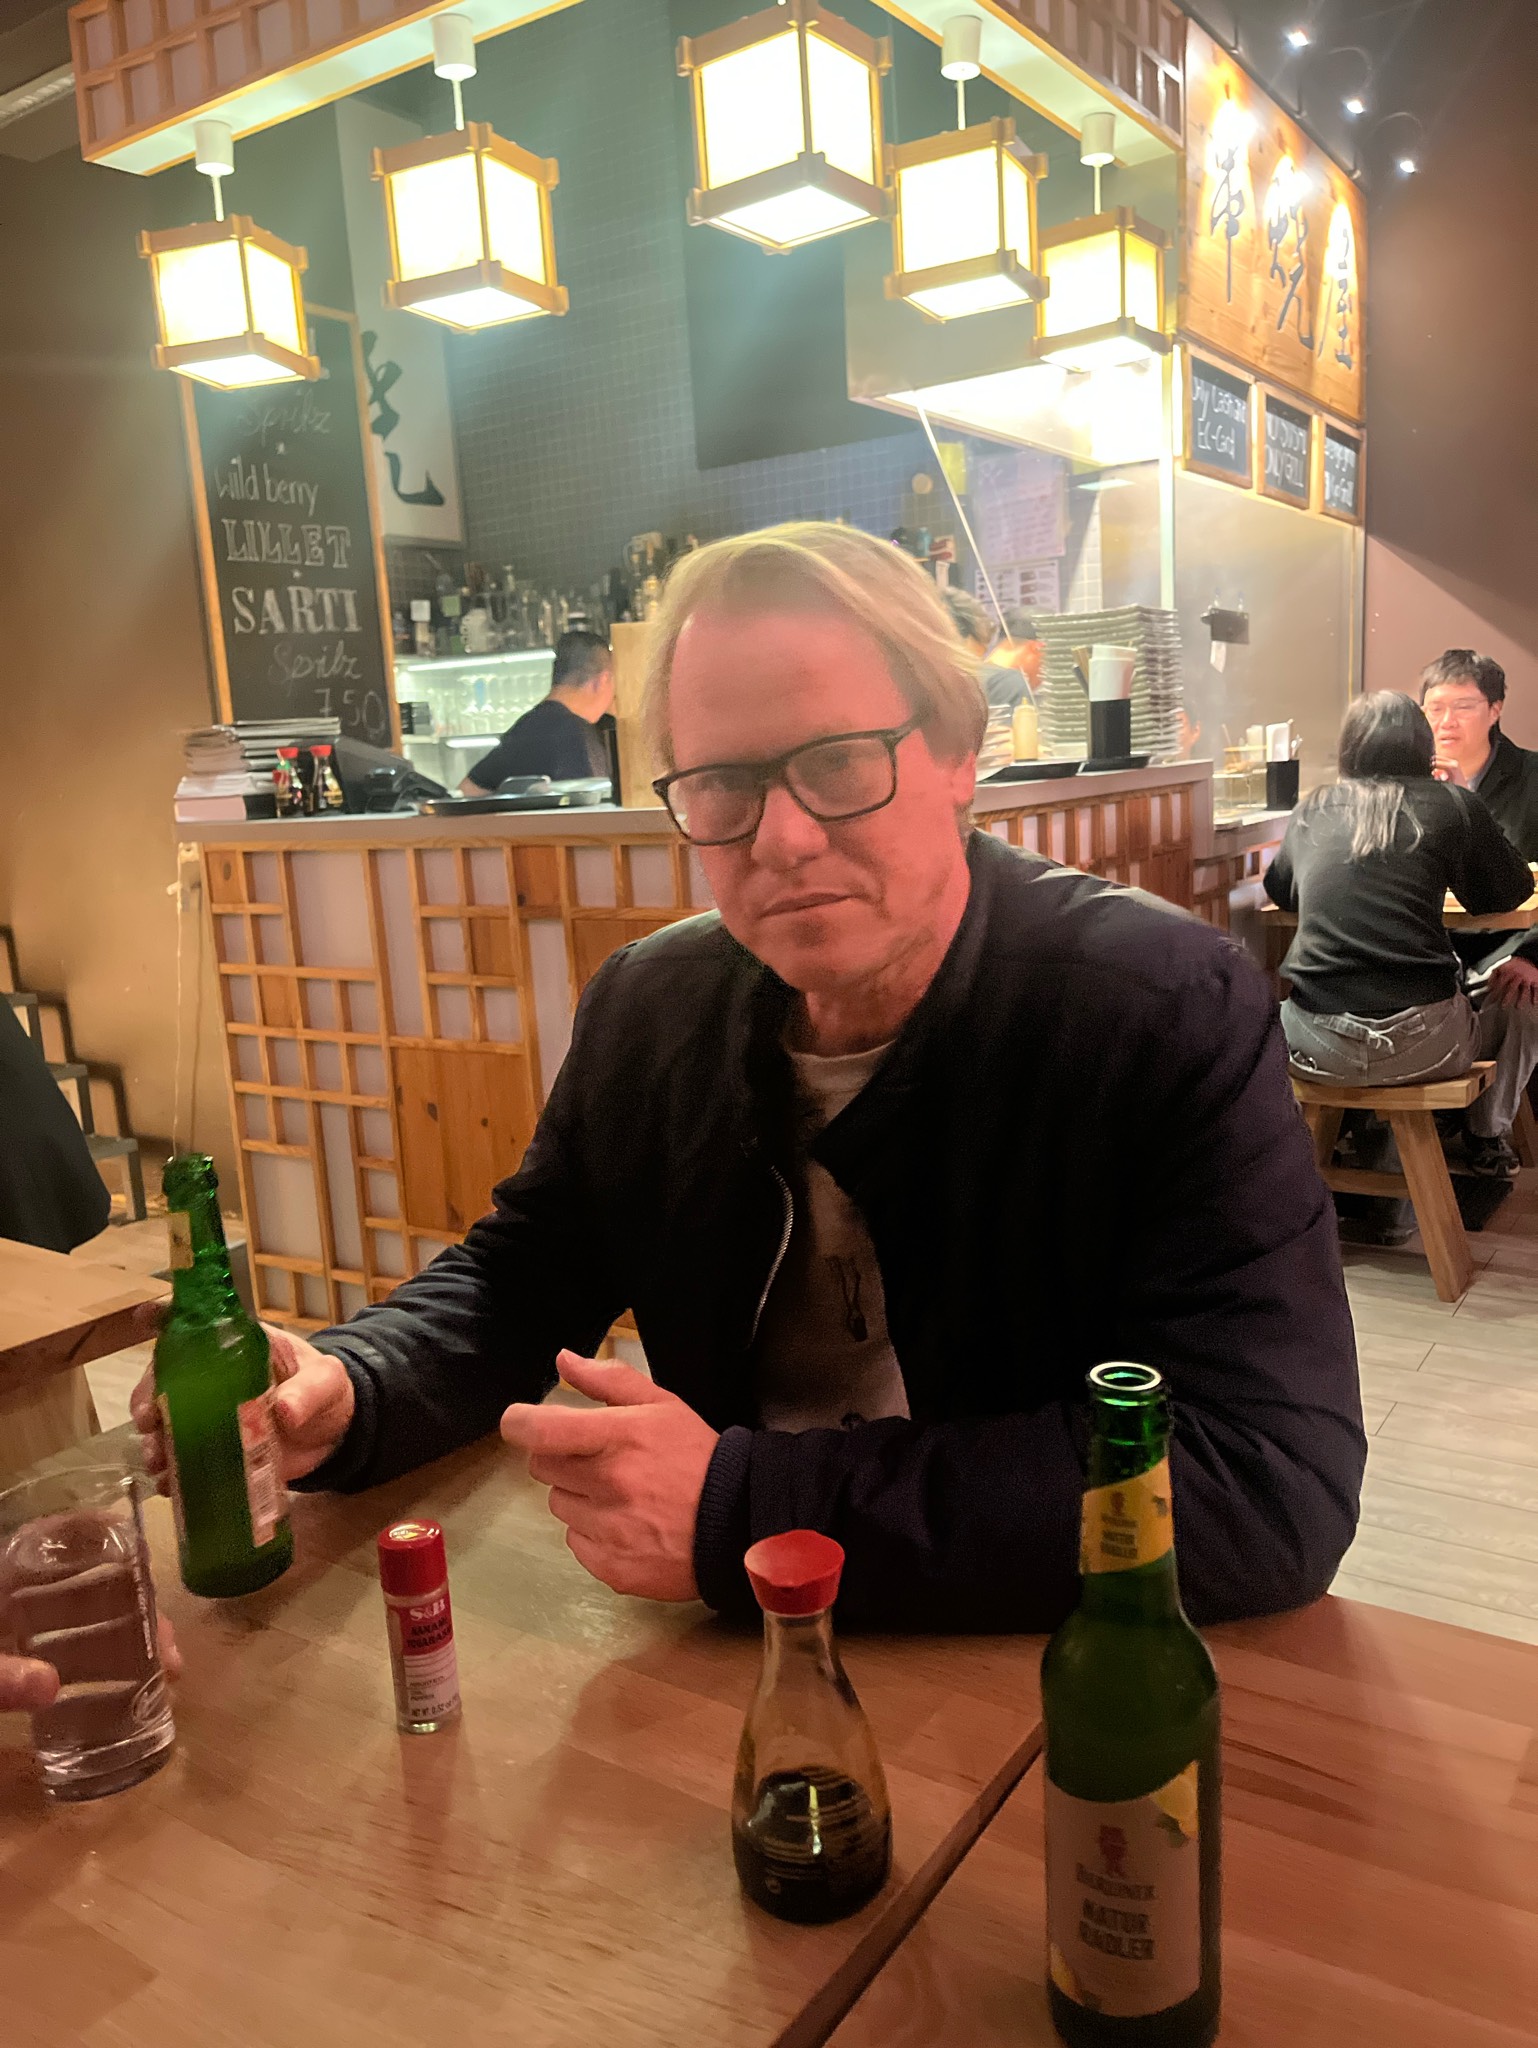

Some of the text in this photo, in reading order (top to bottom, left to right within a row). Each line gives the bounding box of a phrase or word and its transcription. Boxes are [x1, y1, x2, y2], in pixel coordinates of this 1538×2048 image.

[263, 462, 320, 518] berry
[221, 518, 351, 569] LILLET
[232, 585, 362, 635] SARTI
